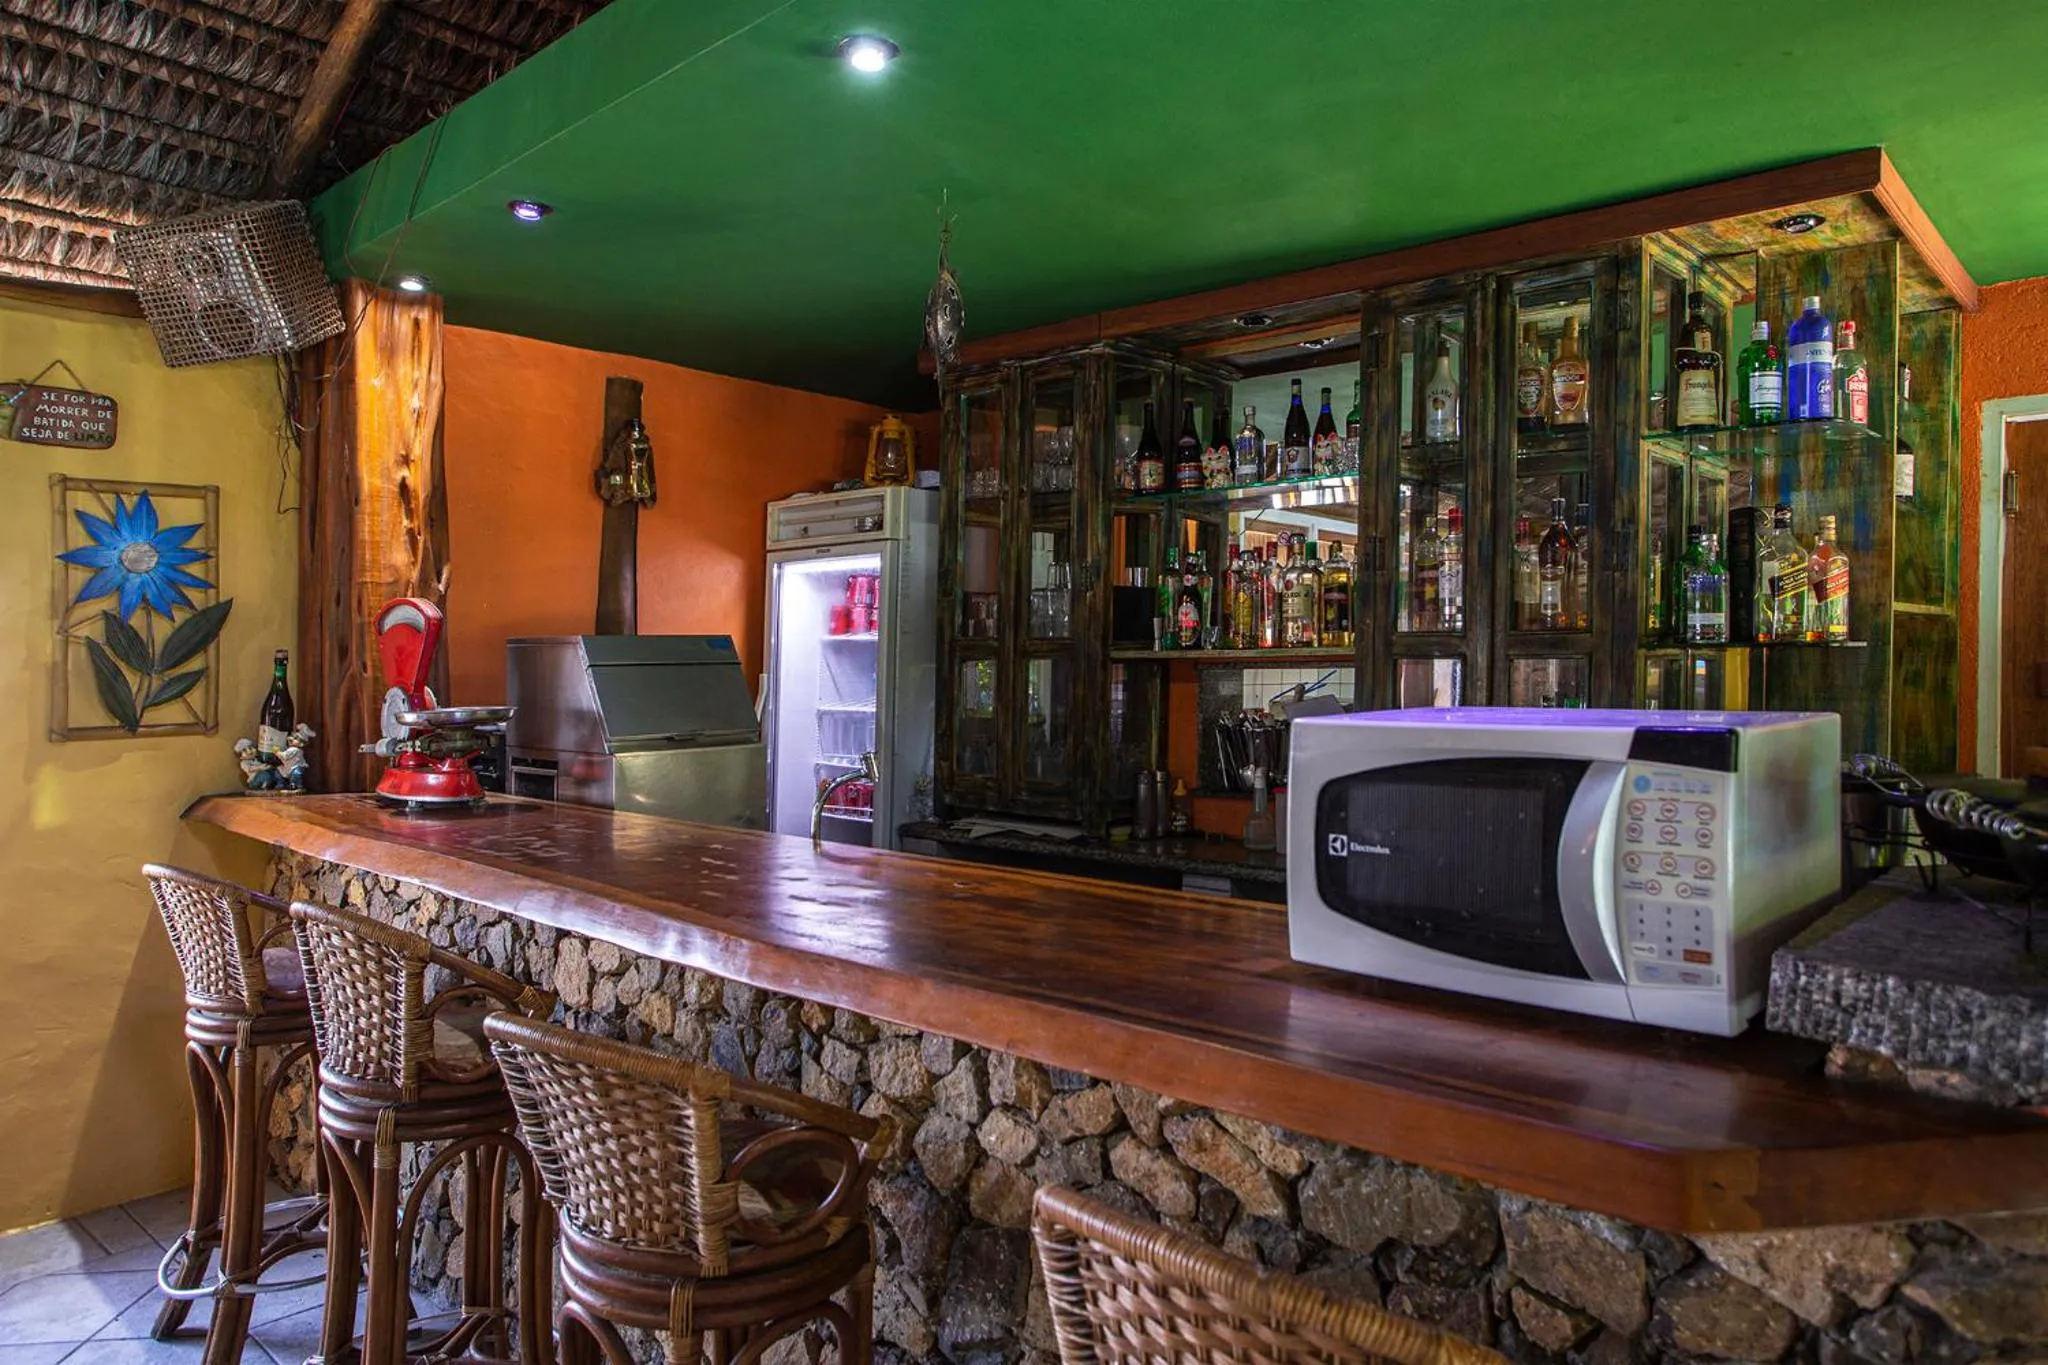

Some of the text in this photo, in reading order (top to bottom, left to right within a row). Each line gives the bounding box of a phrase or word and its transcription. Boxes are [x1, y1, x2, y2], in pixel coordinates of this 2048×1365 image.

[41, 392, 57, 400] SE
[63, 394, 86, 404] FOR
[36, 404, 113, 420] MORRER DE
[33, 416, 106, 431] BATIDA QUE
[21, 427, 53, 438] SEJA
[57, 431, 69, 440] DE
[1350, 841, 1391, 854] Electrolux
